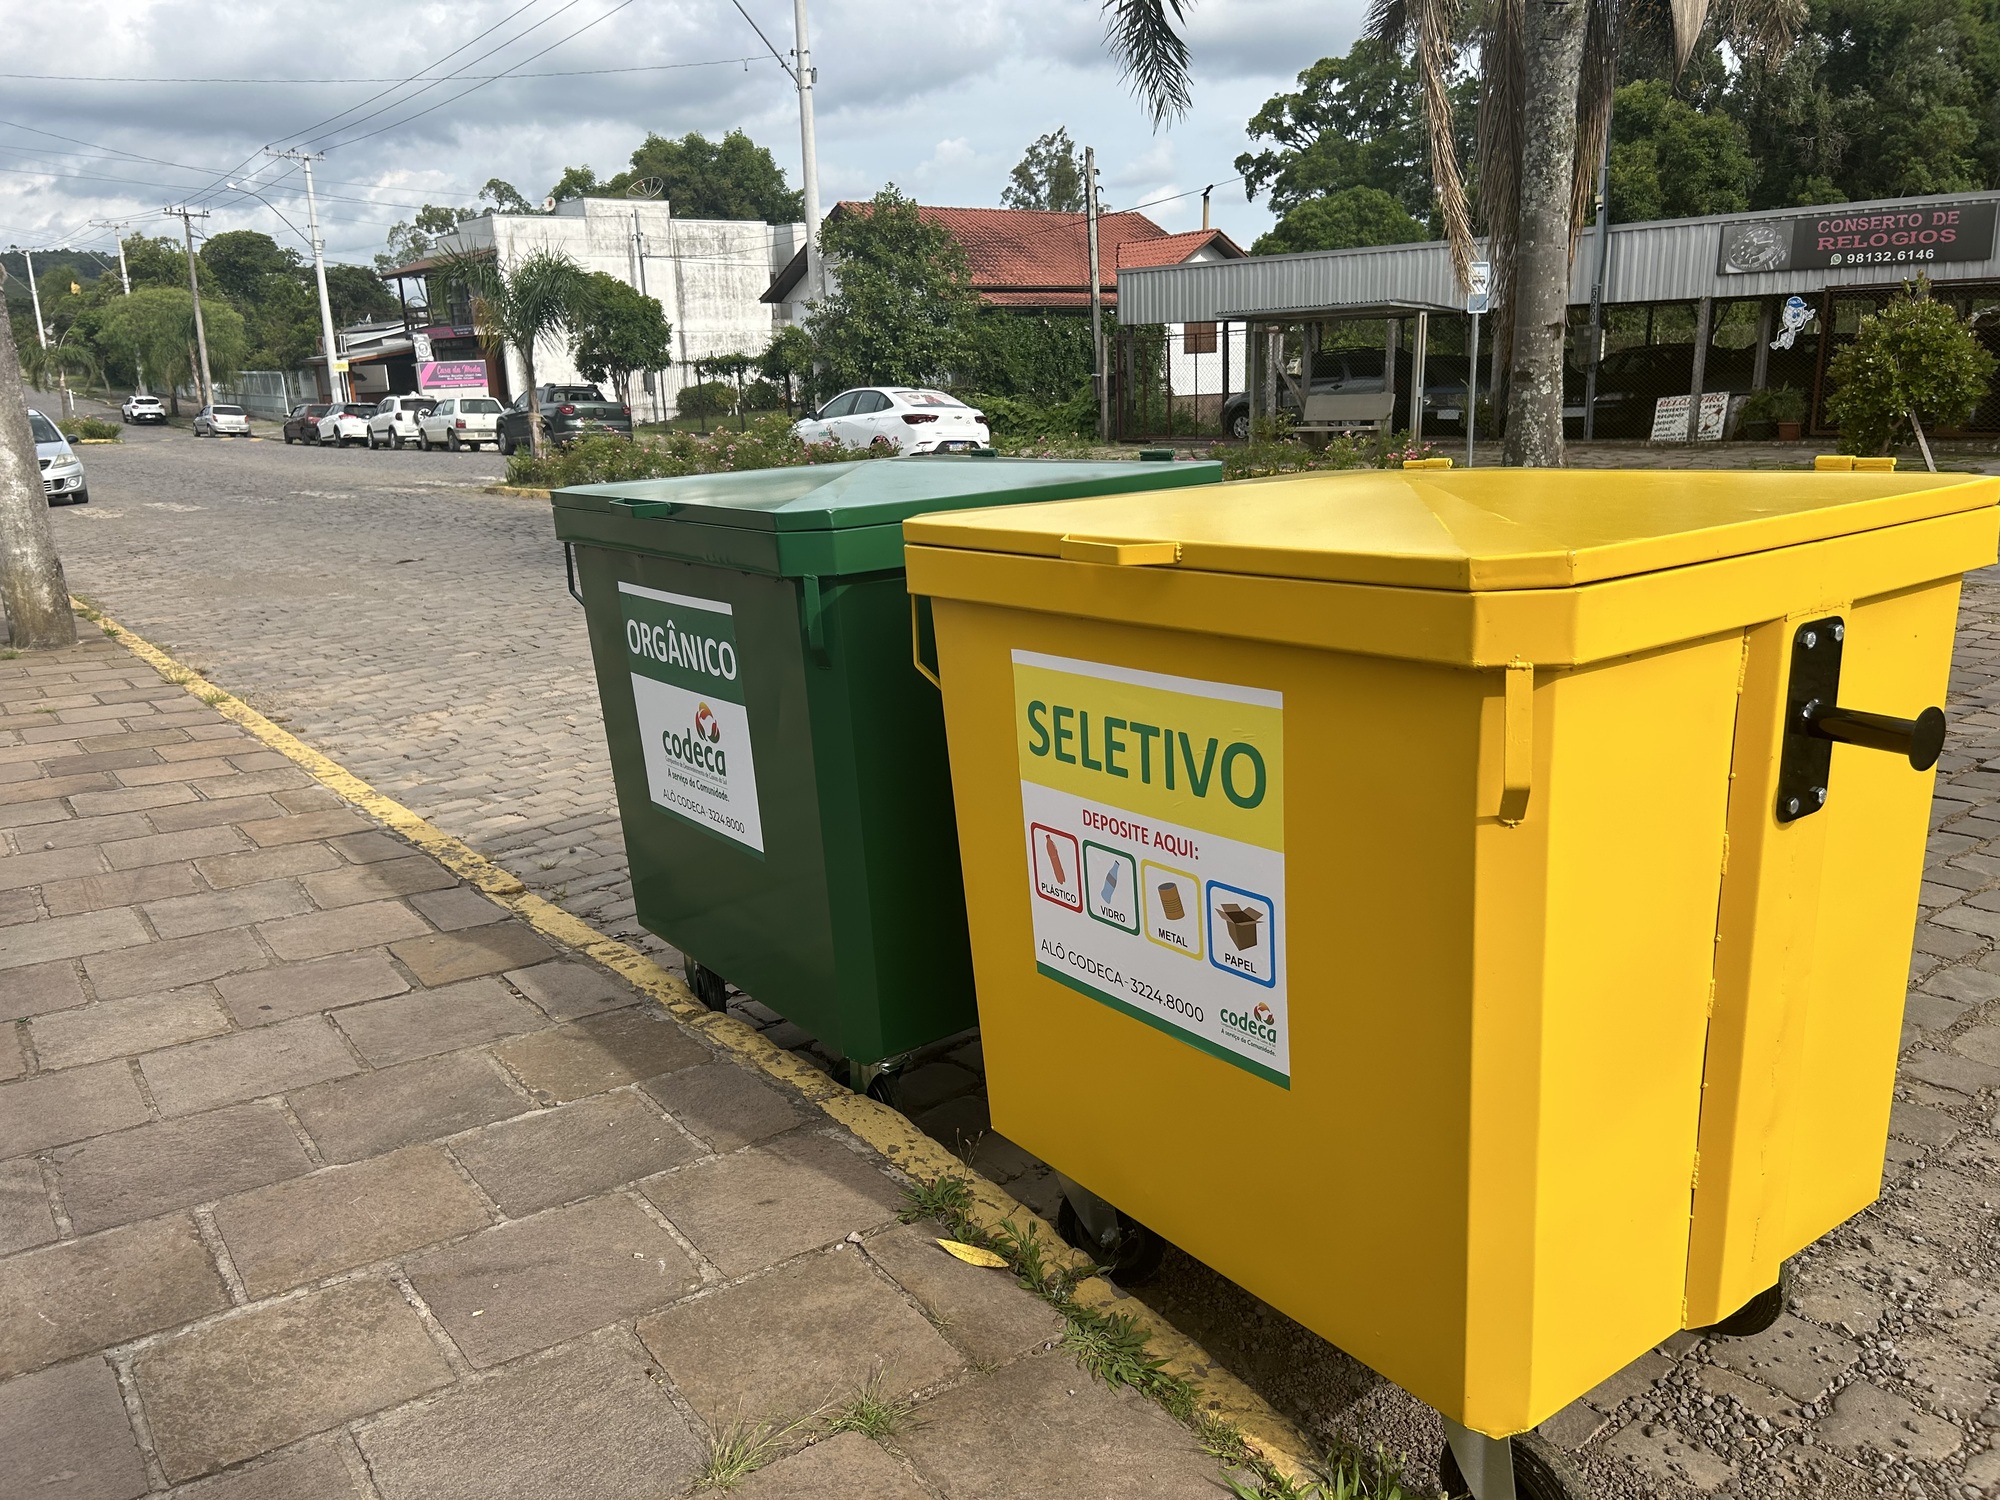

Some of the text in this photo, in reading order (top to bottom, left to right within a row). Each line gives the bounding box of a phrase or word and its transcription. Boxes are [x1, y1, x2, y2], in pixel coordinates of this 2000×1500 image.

[1817, 210, 1961, 234] CONSERTO DE
[1817, 228, 1957, 251] RELÓGIOS
[1846, 249, 1935, 264] 98132.6146
[436, 364, 481, 375] Casa da Moda
[626, 618, 737, 681] ORGÂNICO
[662, 727, 726, 777] codeca
[1027, 700, 1267, 809] SELETIVO
[667, 767, 672, 777] A
[672, 771, 688, 787] serviço
[689, 776, 696, 788] da
[663, 788, 676, 803] ALÔ
[1082, 809, 1200, 860] DEPOSITE AQUI:
[1041, 882, 1077, 904] PLÁSTICO
[1100, 905, 1126, 923] VIDRO
[1158, 927, 1189, 948] METAL
[1041, 938, 1065, 960] ALÔ
[1224, 952, 1257, 974] PAPEL
[1220, 1008, 1277, 1044] codeca
